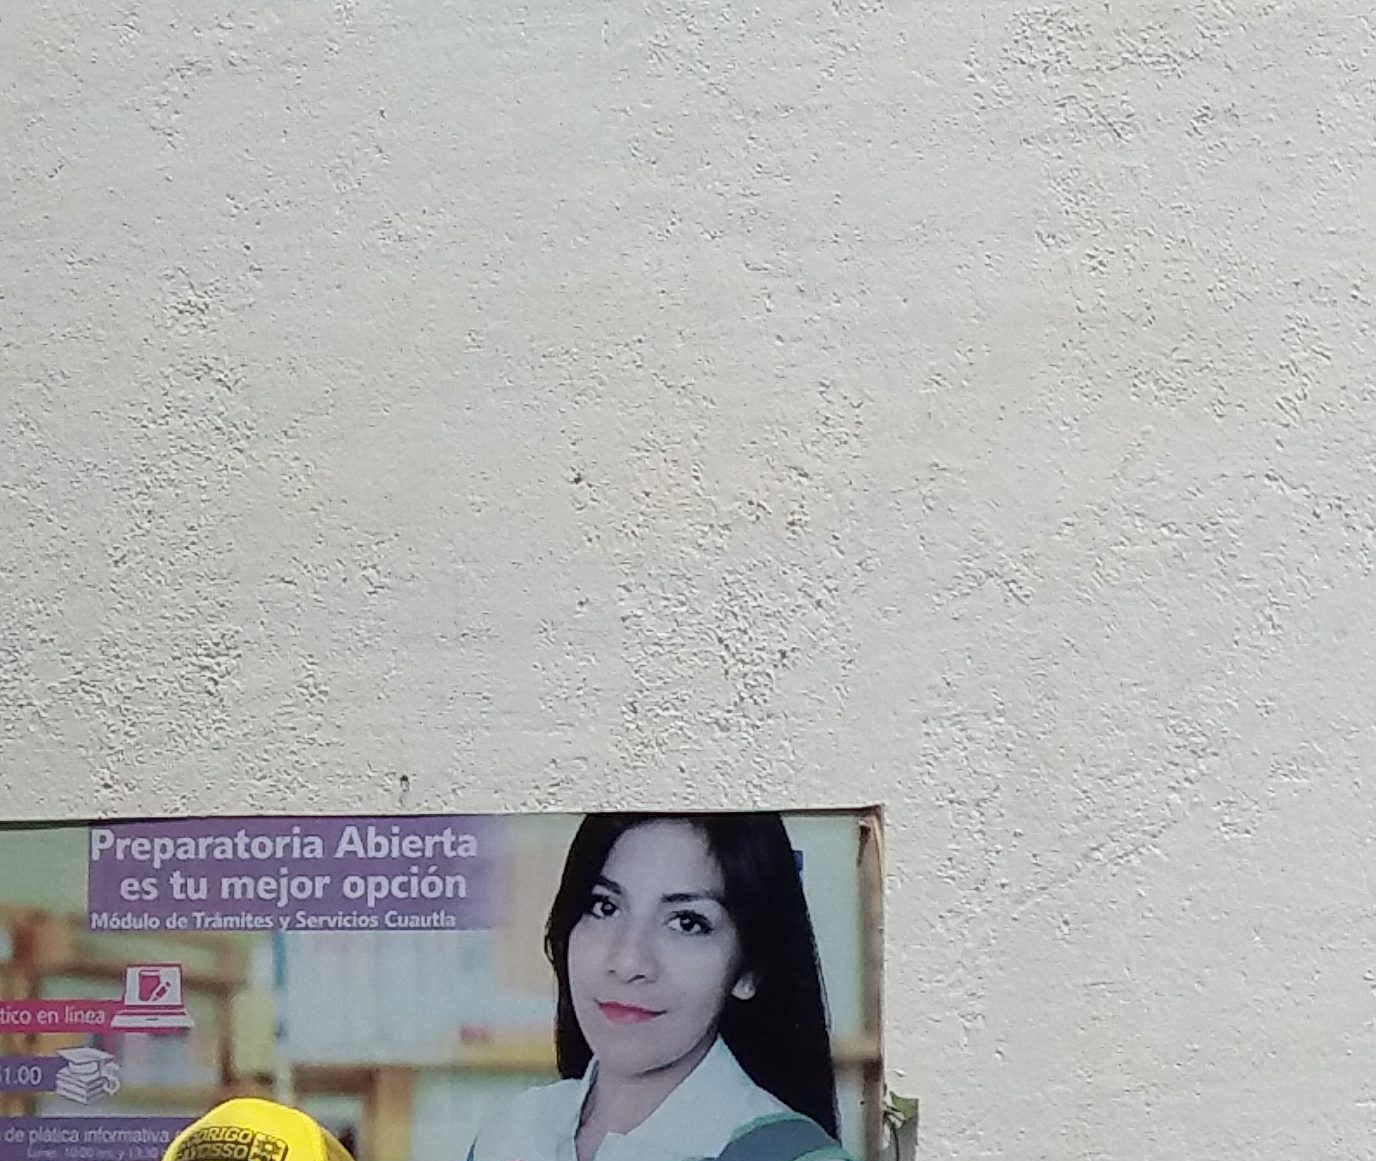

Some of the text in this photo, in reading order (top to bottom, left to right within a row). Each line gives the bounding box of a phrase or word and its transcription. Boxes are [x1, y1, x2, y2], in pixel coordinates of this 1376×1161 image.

[90, 826, 478, 868] Preparatoria Abierta
[119, 865, 467, 907] es tu mejor opción
[90, 910, 457, 931] Módulo de Trámites y Servicios Cuautla
[37, 1011, 59, 1024] en
[65, 1006, 105, 1025] línea
[5, 1126, 170, 1146] de plática informativa
